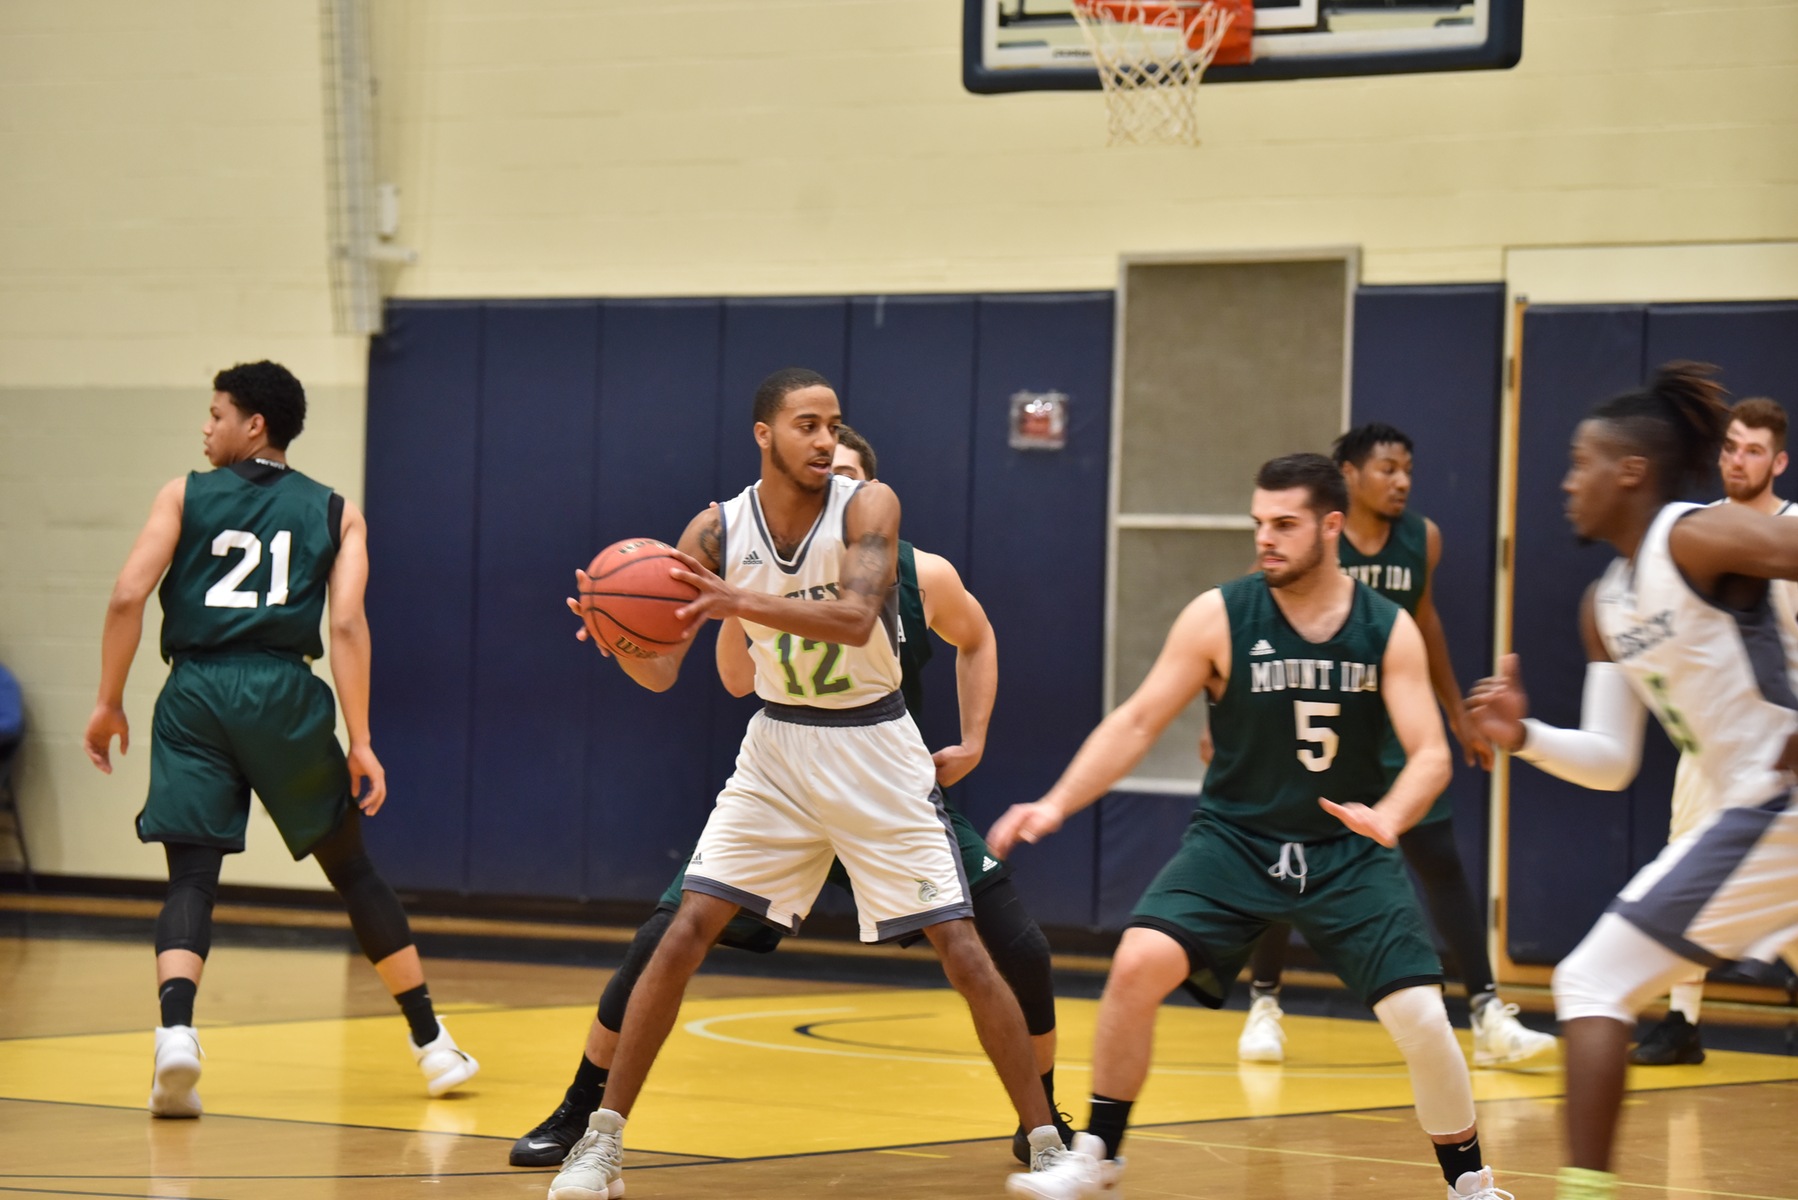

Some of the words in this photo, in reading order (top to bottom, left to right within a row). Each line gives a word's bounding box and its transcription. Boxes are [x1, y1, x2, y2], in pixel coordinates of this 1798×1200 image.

[205, 529, 291, 608] 21
[1385, 565, 1411, 591] IDA
[775, 632, 855, 697] 12
[1250, 659, 1334, 692] MOUNT
[1340, 661, 1377, 692] IDA
[1294, 700, 1341, 771] 5
